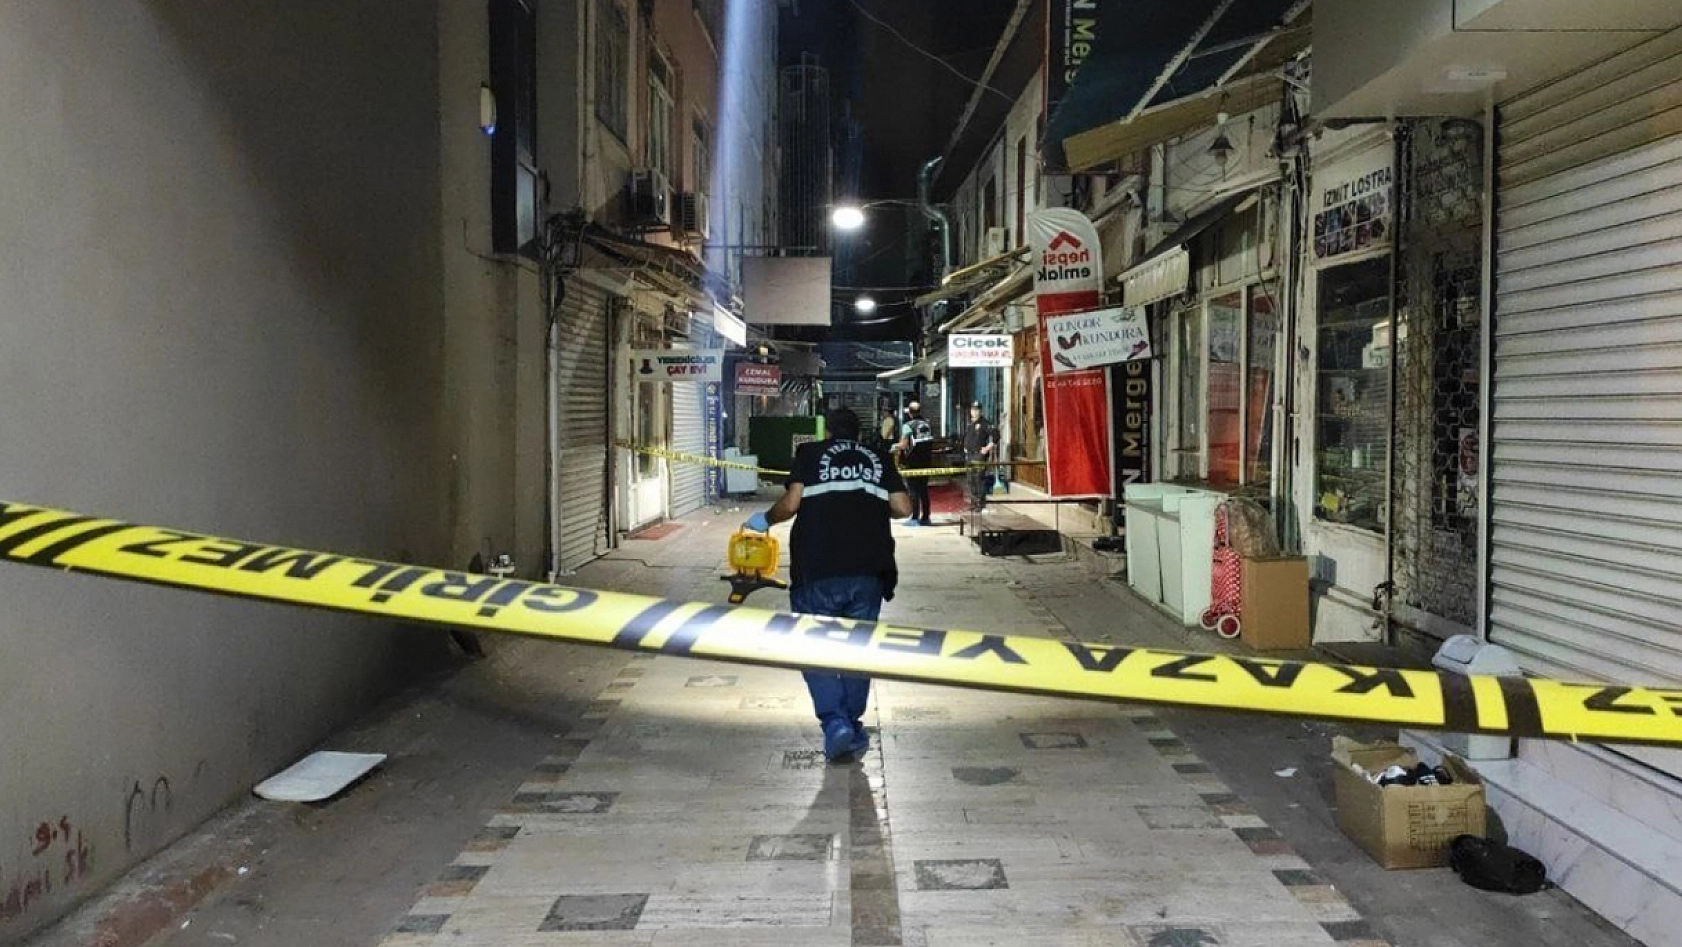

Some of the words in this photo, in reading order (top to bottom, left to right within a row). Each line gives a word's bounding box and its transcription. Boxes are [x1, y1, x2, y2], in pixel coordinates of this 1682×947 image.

[1351, 166, 1392, 197] LOSTRA
[1080, 326, 1145, 346] KUNDURA
[666, 365, 687, 377] ÇAY
[117, 529, 598, 618] GİRİLMEZ
[1061, 641, 1415, 698] KAZA
